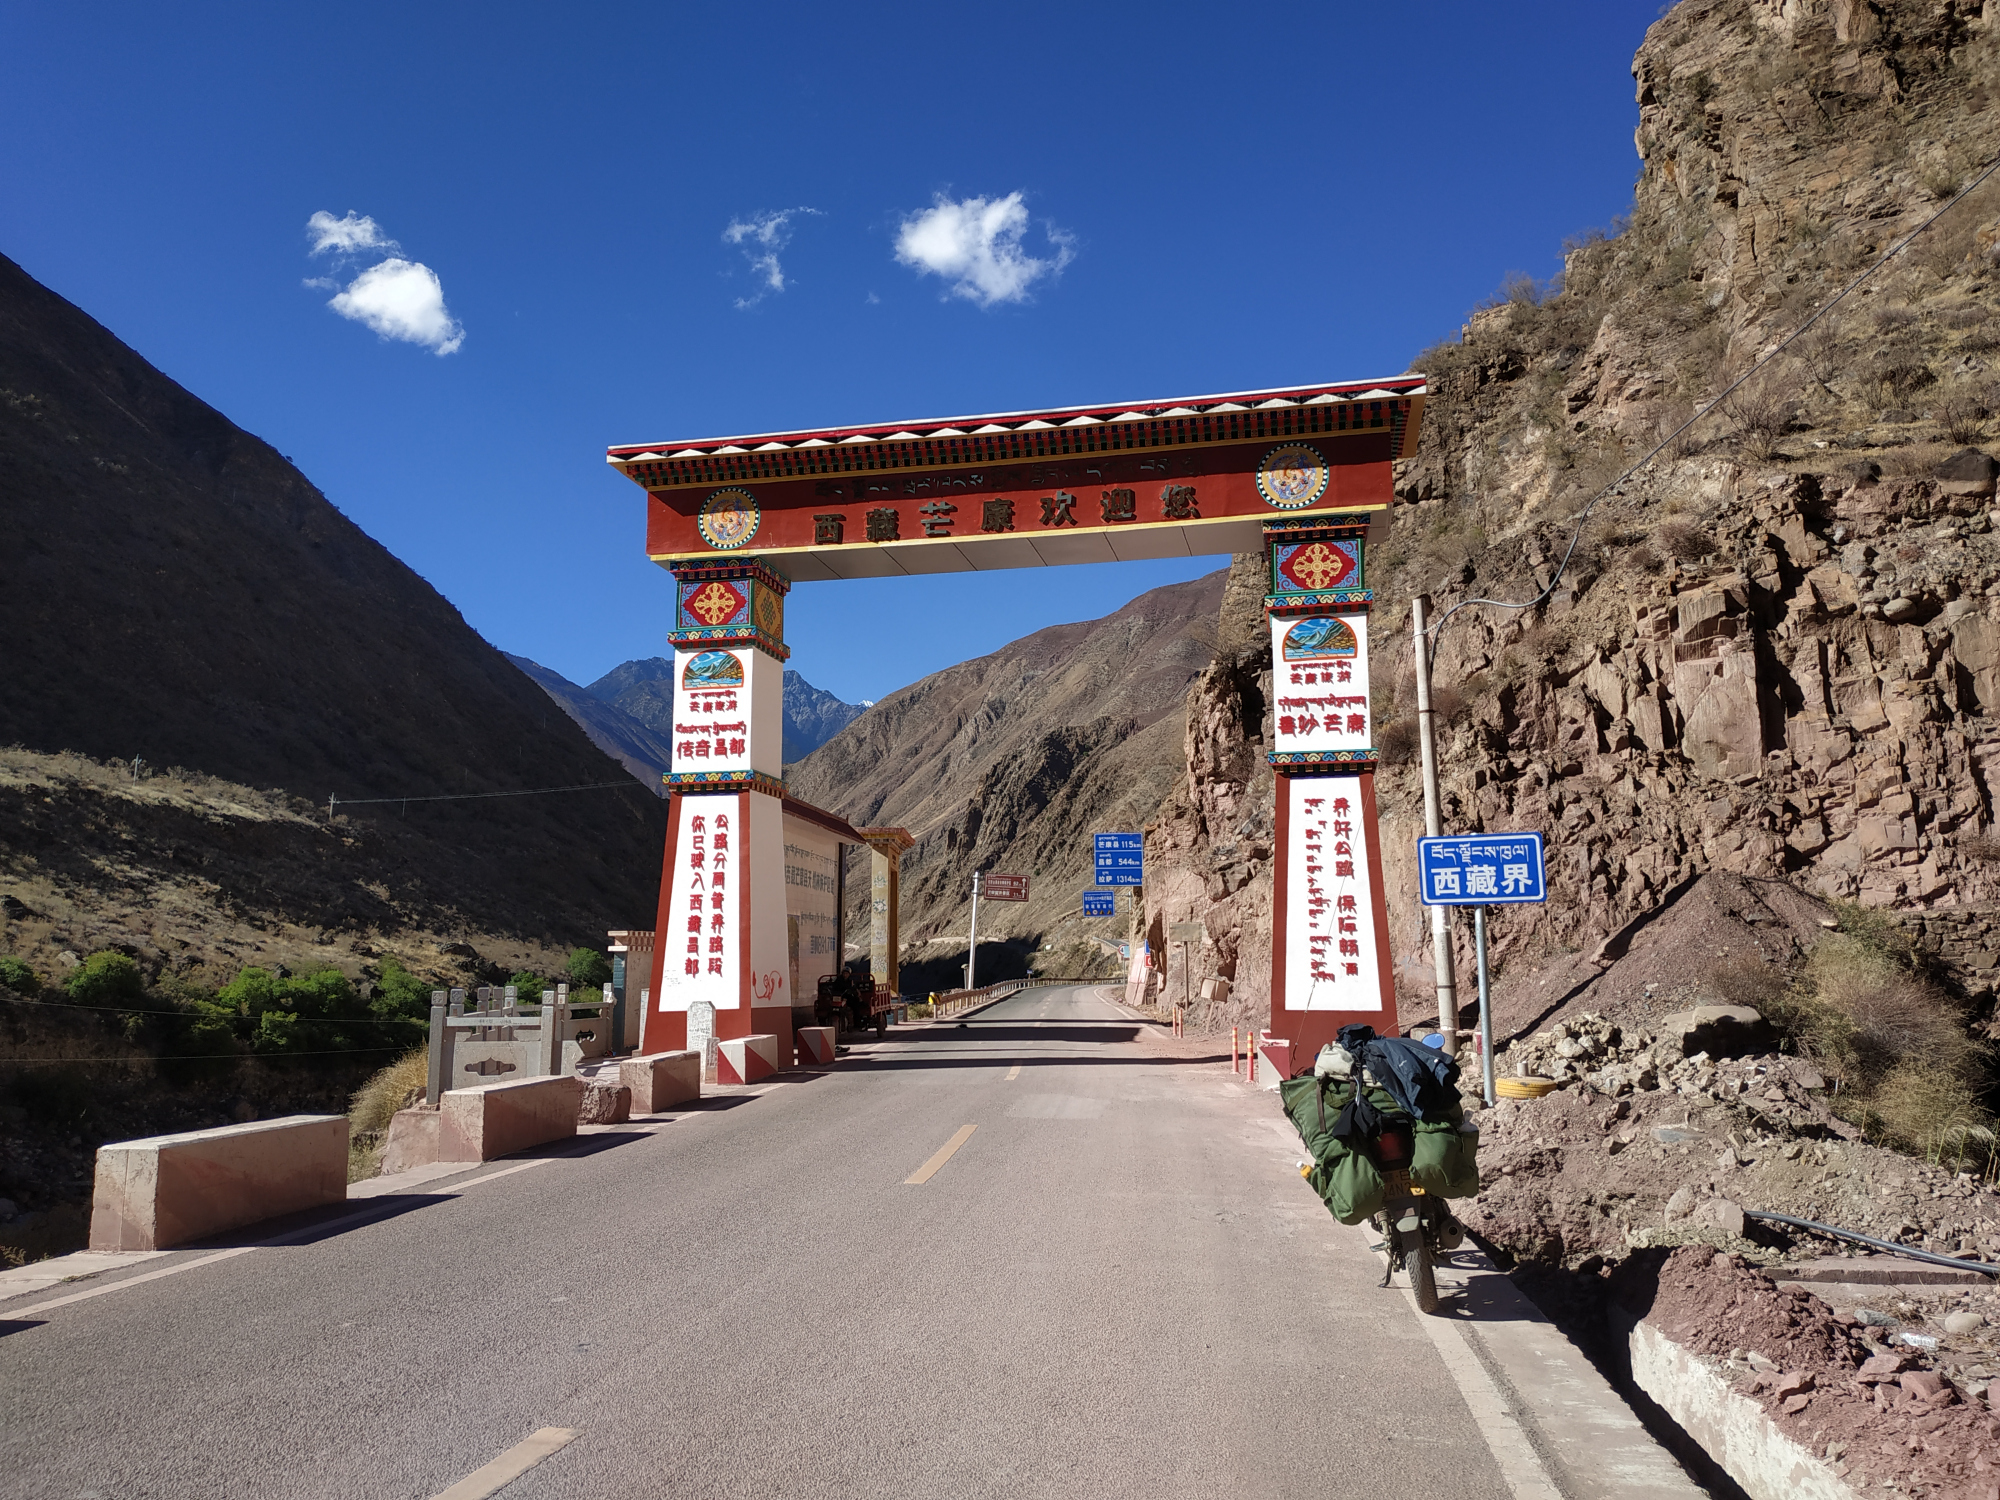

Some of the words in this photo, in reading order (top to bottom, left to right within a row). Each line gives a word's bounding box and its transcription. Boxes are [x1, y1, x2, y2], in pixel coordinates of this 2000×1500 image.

[812, 483, 1202, 544] 西藏芒康欢迎您
[1290, 671, 1352, 688] 芒康旅游
[689, 699, 738, 714] 芒康旅游
[676, 737, 746, 761] 传奇昌都
[708, 813, 729, 978] 公路分局管养路段
[1430, 863, 1533, 896] 西藏界
[685, 814, 706, 979] 你已驶入西藏昌都
